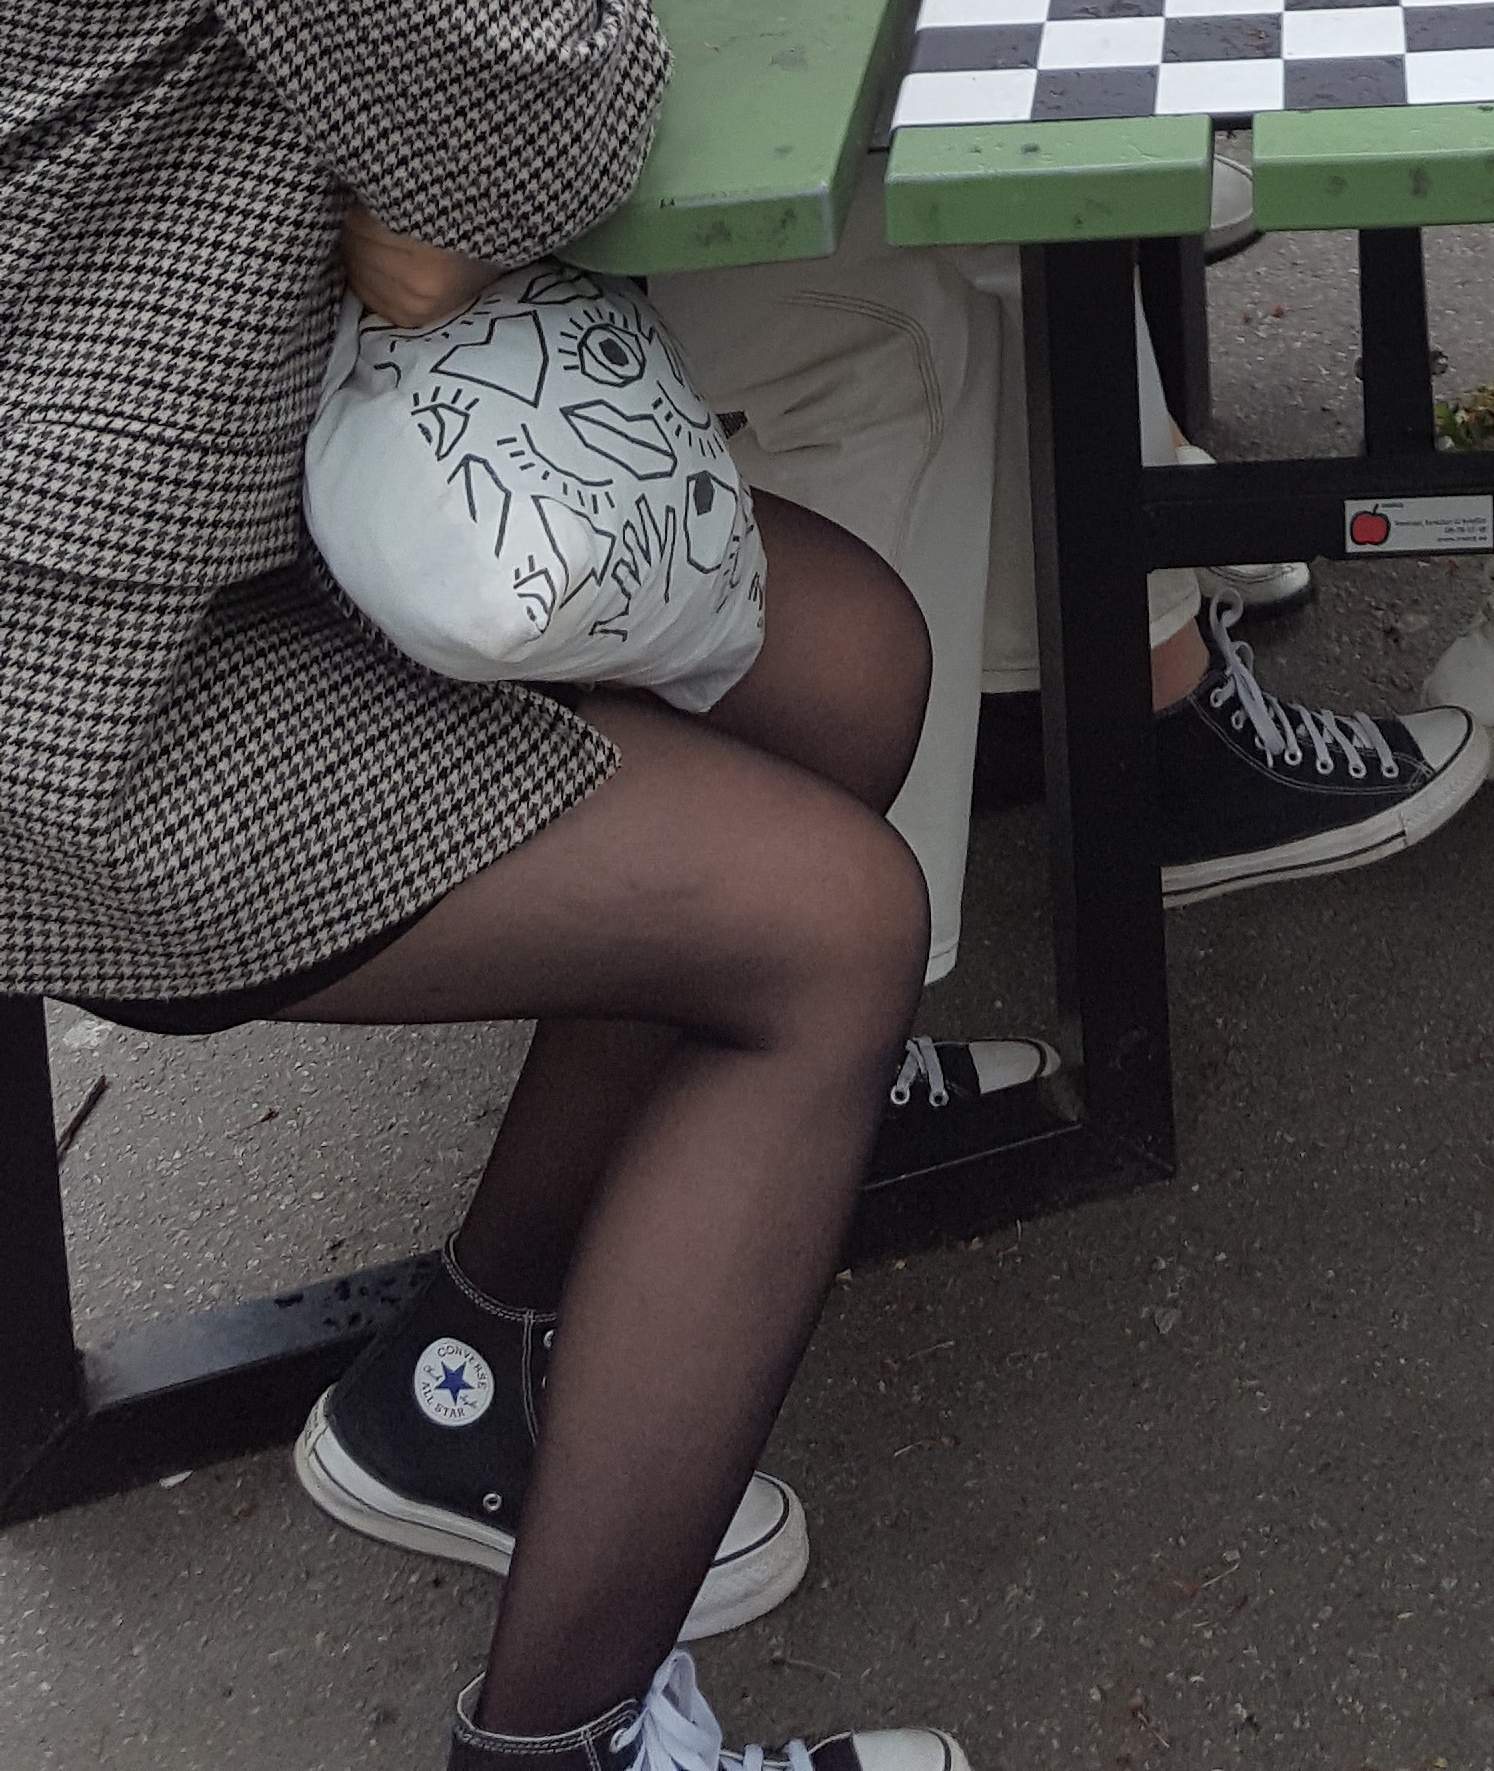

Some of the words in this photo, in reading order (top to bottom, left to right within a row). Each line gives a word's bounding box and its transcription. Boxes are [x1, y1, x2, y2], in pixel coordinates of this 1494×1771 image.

[438, 1345, 487, 1390] CONVERSE
[421, 1381, 435, 1405] ALL
[434, 1403, 466, 1419] STAR
